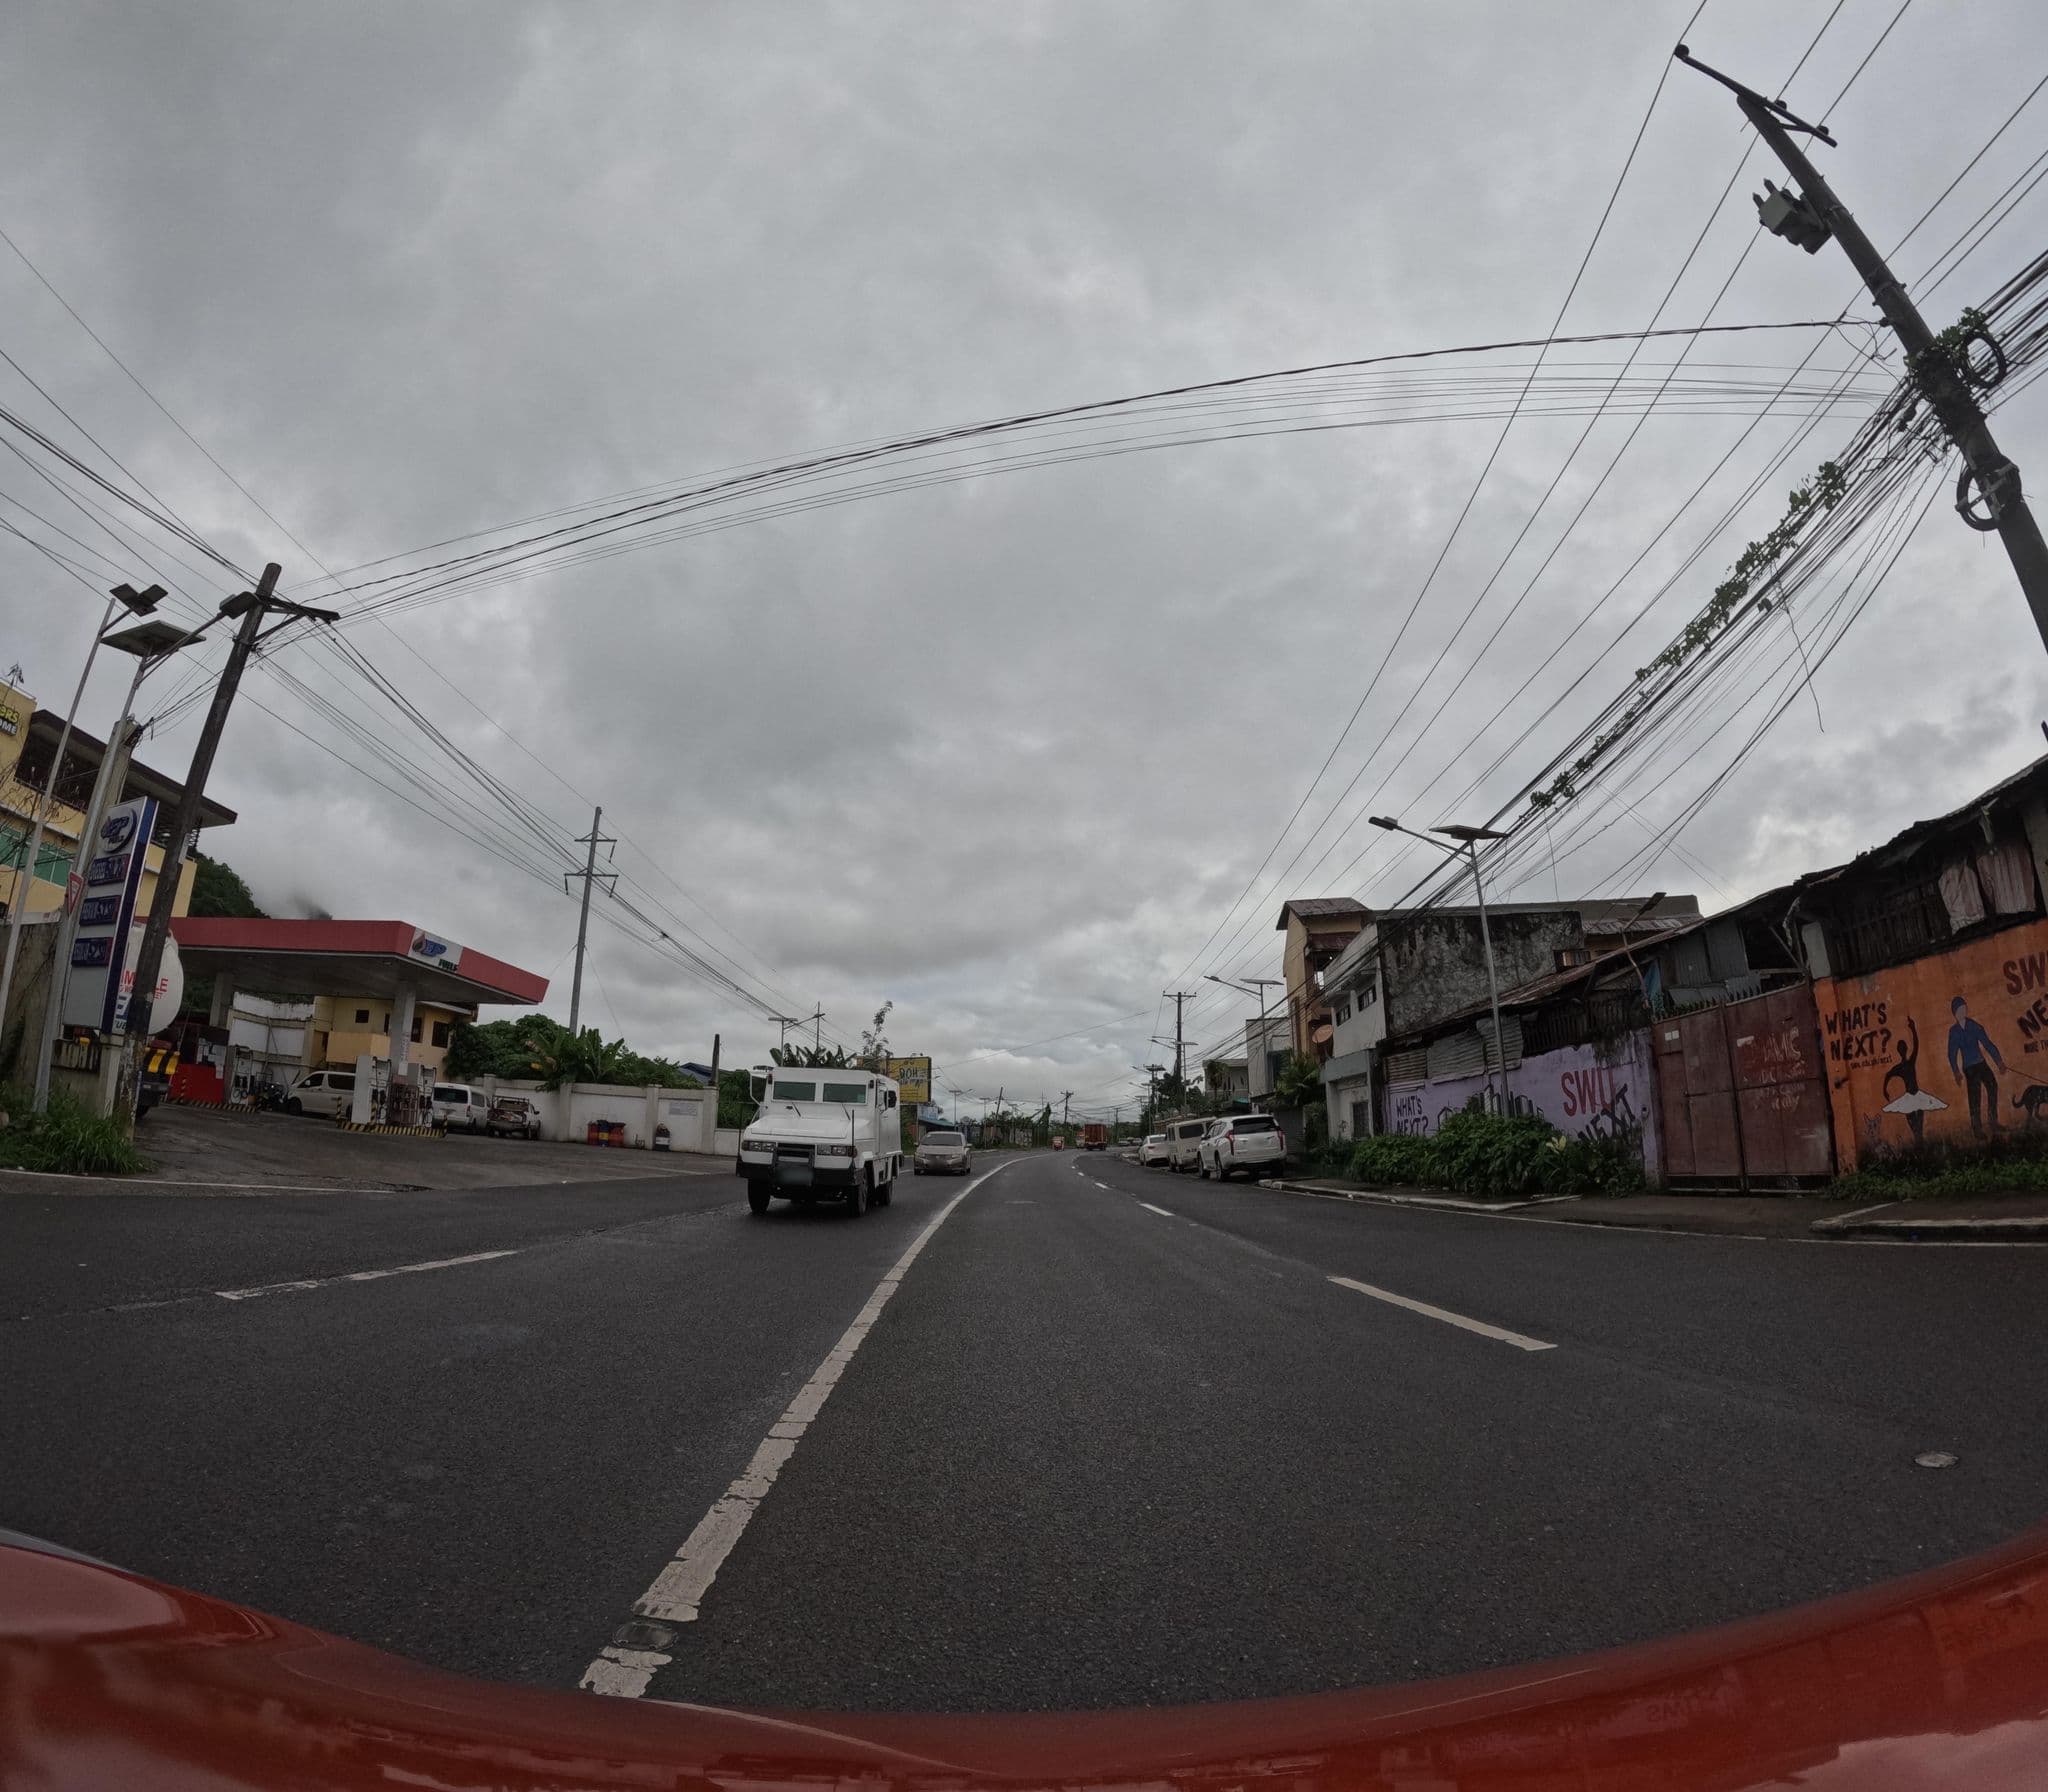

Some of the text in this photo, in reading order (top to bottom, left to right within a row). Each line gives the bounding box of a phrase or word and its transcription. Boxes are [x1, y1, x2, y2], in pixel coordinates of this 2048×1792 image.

[2002, 948, 2048, 996] SW
[1824, 1002, 1888, 1035] WHAT'S
[2016, 993, 2048, 1039] NE
[1830, 1028, 1892, 1061] NEXT?
[1395, 1094, 1423, 1118] WHAT'S
[1560, 1066, 1617, 1118] SWU
[1395, 1115, 1430, 1137] NEXT?
